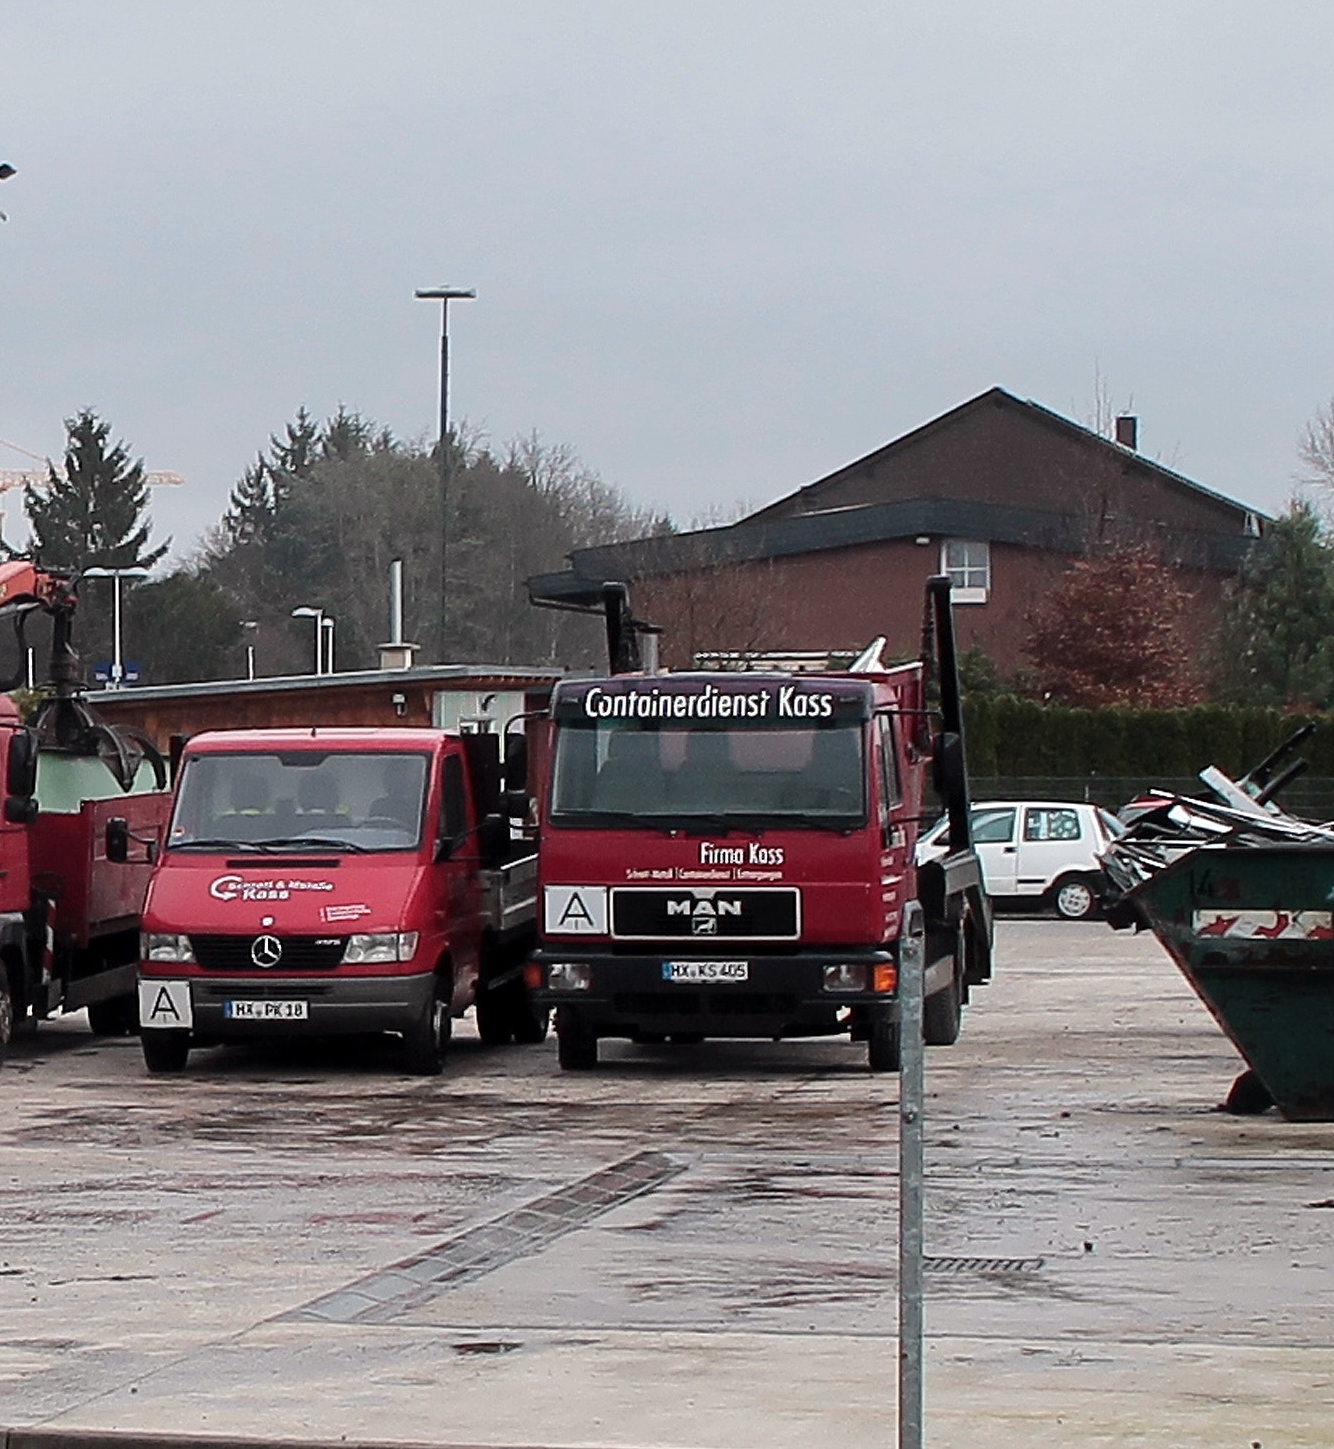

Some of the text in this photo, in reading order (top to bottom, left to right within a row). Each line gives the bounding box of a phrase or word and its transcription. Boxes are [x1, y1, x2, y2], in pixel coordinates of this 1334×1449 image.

[584, 684, 833, 718] Containerdienst Kass
[700, 842, 785, 865] Firma Kass
[558, 890, 594, 926] A
[667, 899, 742, 916] MAN
[698, 964, 717, 977] KS
[149, 985, 181, 1021] A
